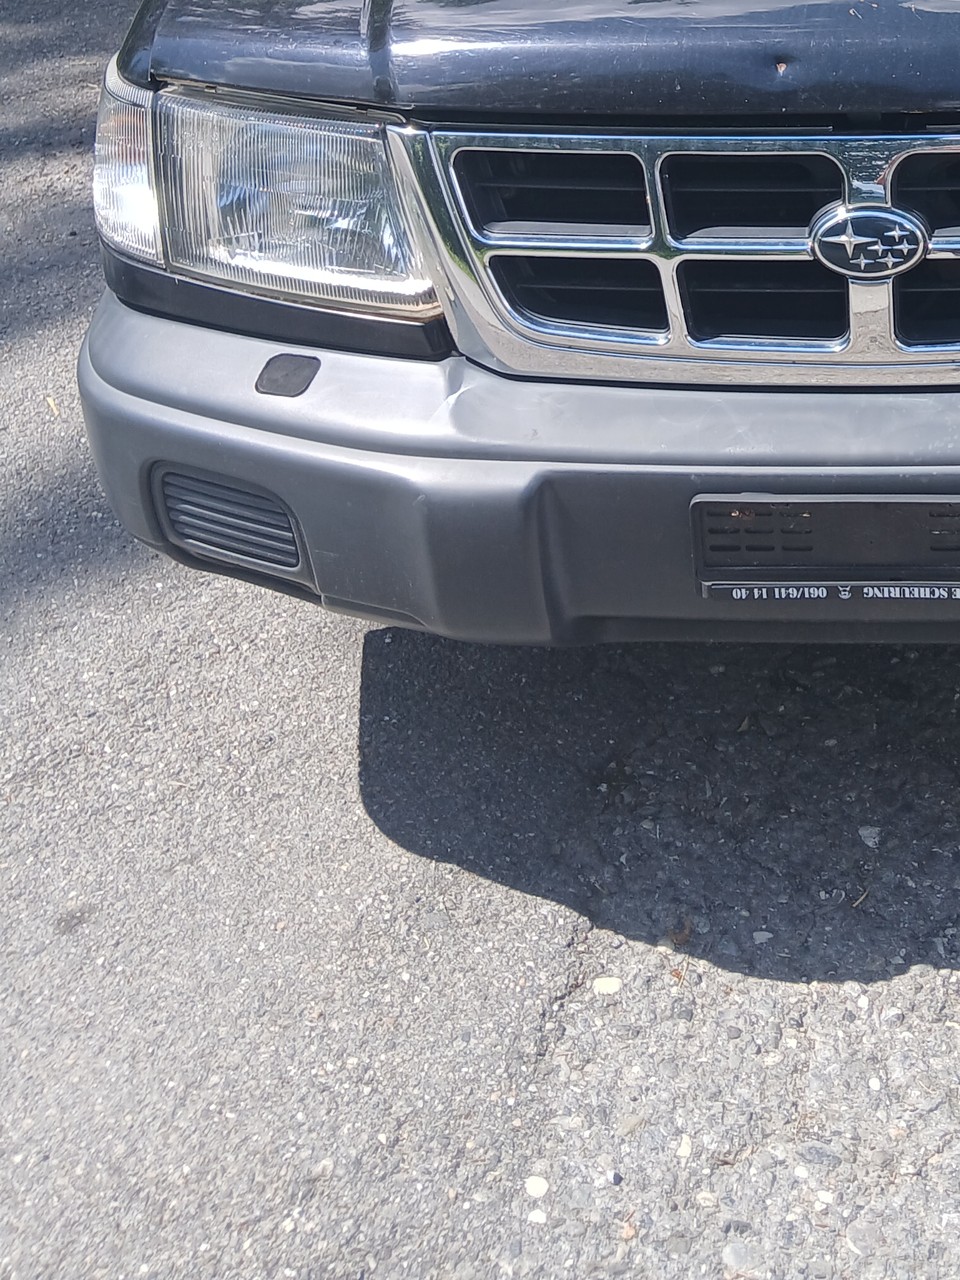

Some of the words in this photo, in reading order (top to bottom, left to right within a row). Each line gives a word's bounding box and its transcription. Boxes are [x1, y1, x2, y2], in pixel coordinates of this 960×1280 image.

[732, 588, 750, 600] 40
[753, 587, 768, 599] 14
[774, 587, 828, 599] 061/641
[863, 586, 948, 599] SCHEURING
